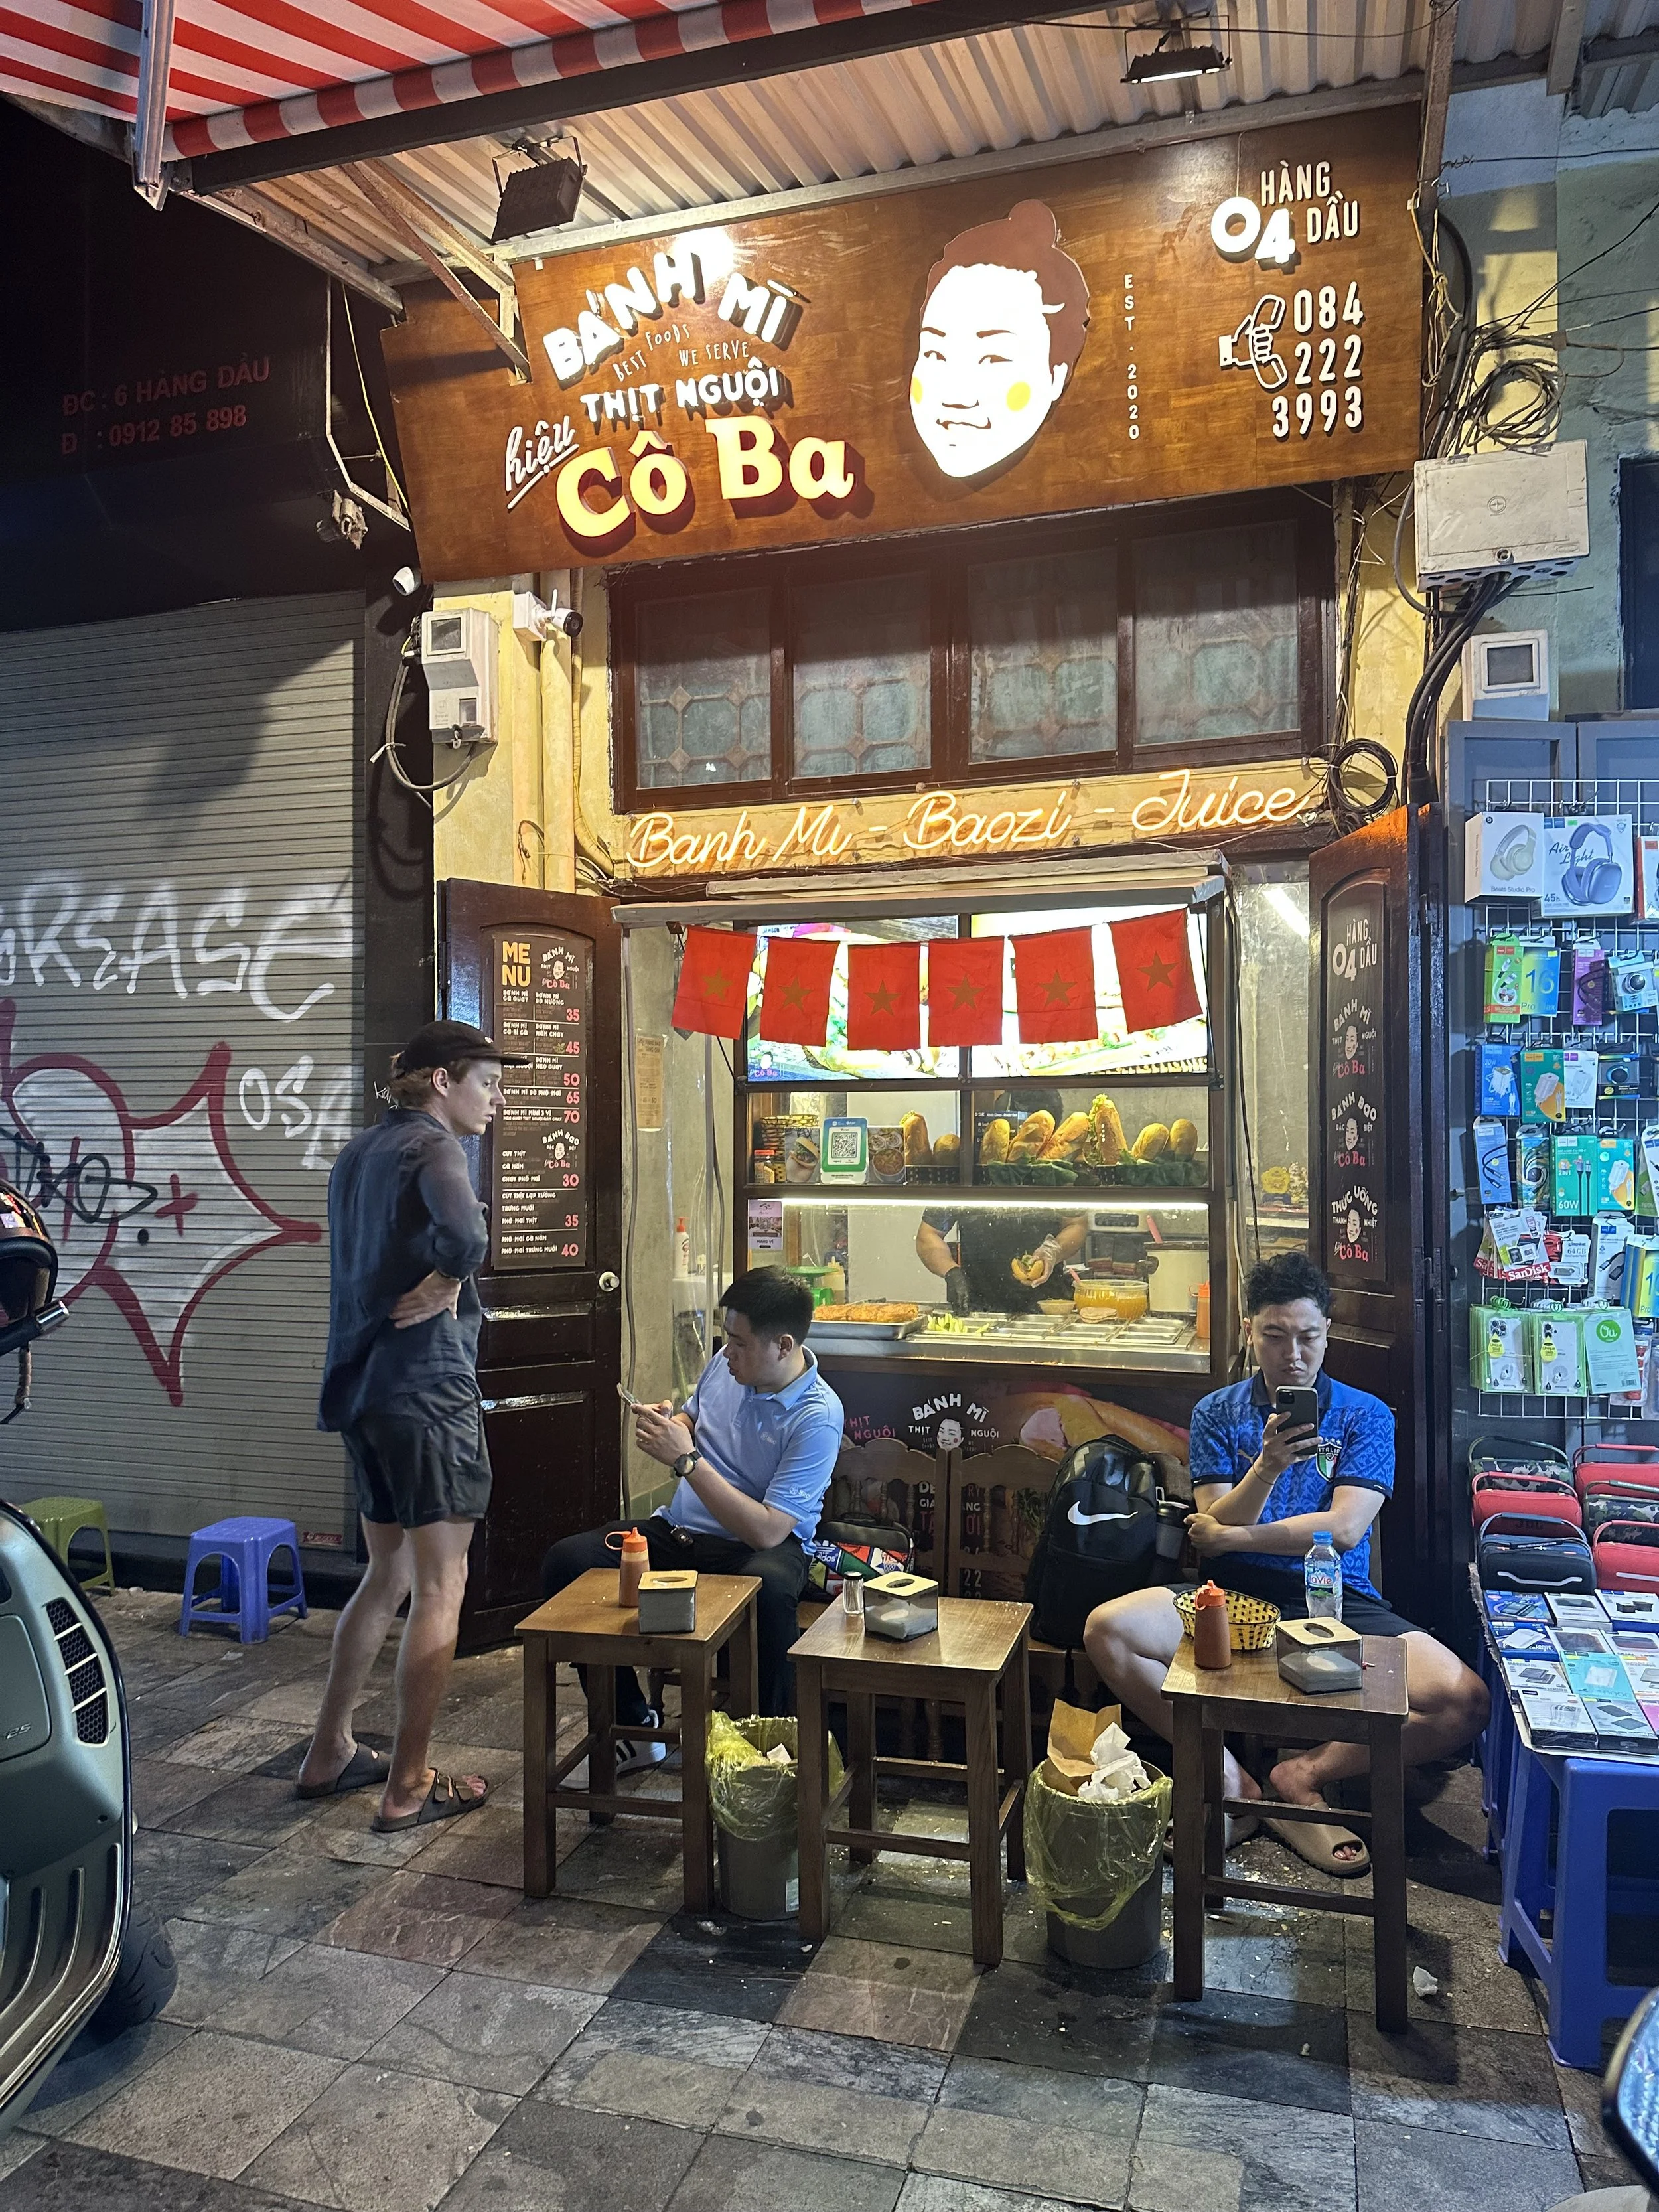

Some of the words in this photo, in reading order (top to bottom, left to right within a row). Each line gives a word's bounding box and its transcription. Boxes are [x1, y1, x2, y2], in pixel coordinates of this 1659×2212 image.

[1261, 161, 1331, 206] HÀNG
[1211, 196, 1295, 264] 04
[1307, 190, 1358, 243] DẦU
[543, 252, 702, 380] BÁNH
[719, 273, 796, 342] MÌ
[1293, 281, 1363, 332] 084
[614, 350, 646, 382] BEST
[646, 323, 691, 352] FOODS
[679, 349, 698, 367] WE
[706, 341, 749, 361] SERVE
[1295, 334, 1362, 385] 222
[115, 385, 127, 406] 6
[581, 384, 659, 422] THỊT
[676, 357, 779, 408] NGUỘI
[1127, 364, 1139, 440] 2020
[109, 420, 159, 447] 0912
[169, 413, 197, 437] 85
[206, 404, 246, 432] 898
[1272, 386, 1362, 437] 3993
[505, 415, 576, 492] hiệu
[555, 430, 687, 537] Cô
[705, 415, 855, 500] Ba
[628, 810, 767, 867] Banh
[904, 790, 1072, 850] Baozi
[1132, 769, 1309, 830] Juice
[1550, 842, 1569, 855] Air
[1560, 849, 1594, 866] Lght
[1346, 918, 1368, 946] HÀNG
[502, 941, 531, 964] ME
[1332, 942, 1357, 982] 04
[1360, 936, 1378, 969] DẦU
[502, 964, 531, 987] NU
[566, 1008, 580, 1021] 35
[1333, 998, 1358, 1032] BÁNH
[1359, 1005, 1372, 1025] MÌ
[565, 1041, 580, 1054] 45
[563, 1073, 580, 1086] 50
[566, 1091, 580, 1104] 65
[1331, 1091, 1356, 1121] BÁNH
[563, 1110, 580, 1123] 70
[562, 1173, 579, 1187] 30
[1559, 1200, 1579, 1209] 60W
[565, 1214, 579, 1227] 35
[561, 1243, 579, 1257] 40
[1340, 1243, 1352, 1260] Cô
[1354, 1244, 1368, 1262] Ba
[1508, 1264, 1550, 1281] SanDisk
[912, 1393, 962, 1420] BÁNH
[966, 1402, 990, 1423] MÌ
[970, 1428, 999, 1439] NGUỘI
